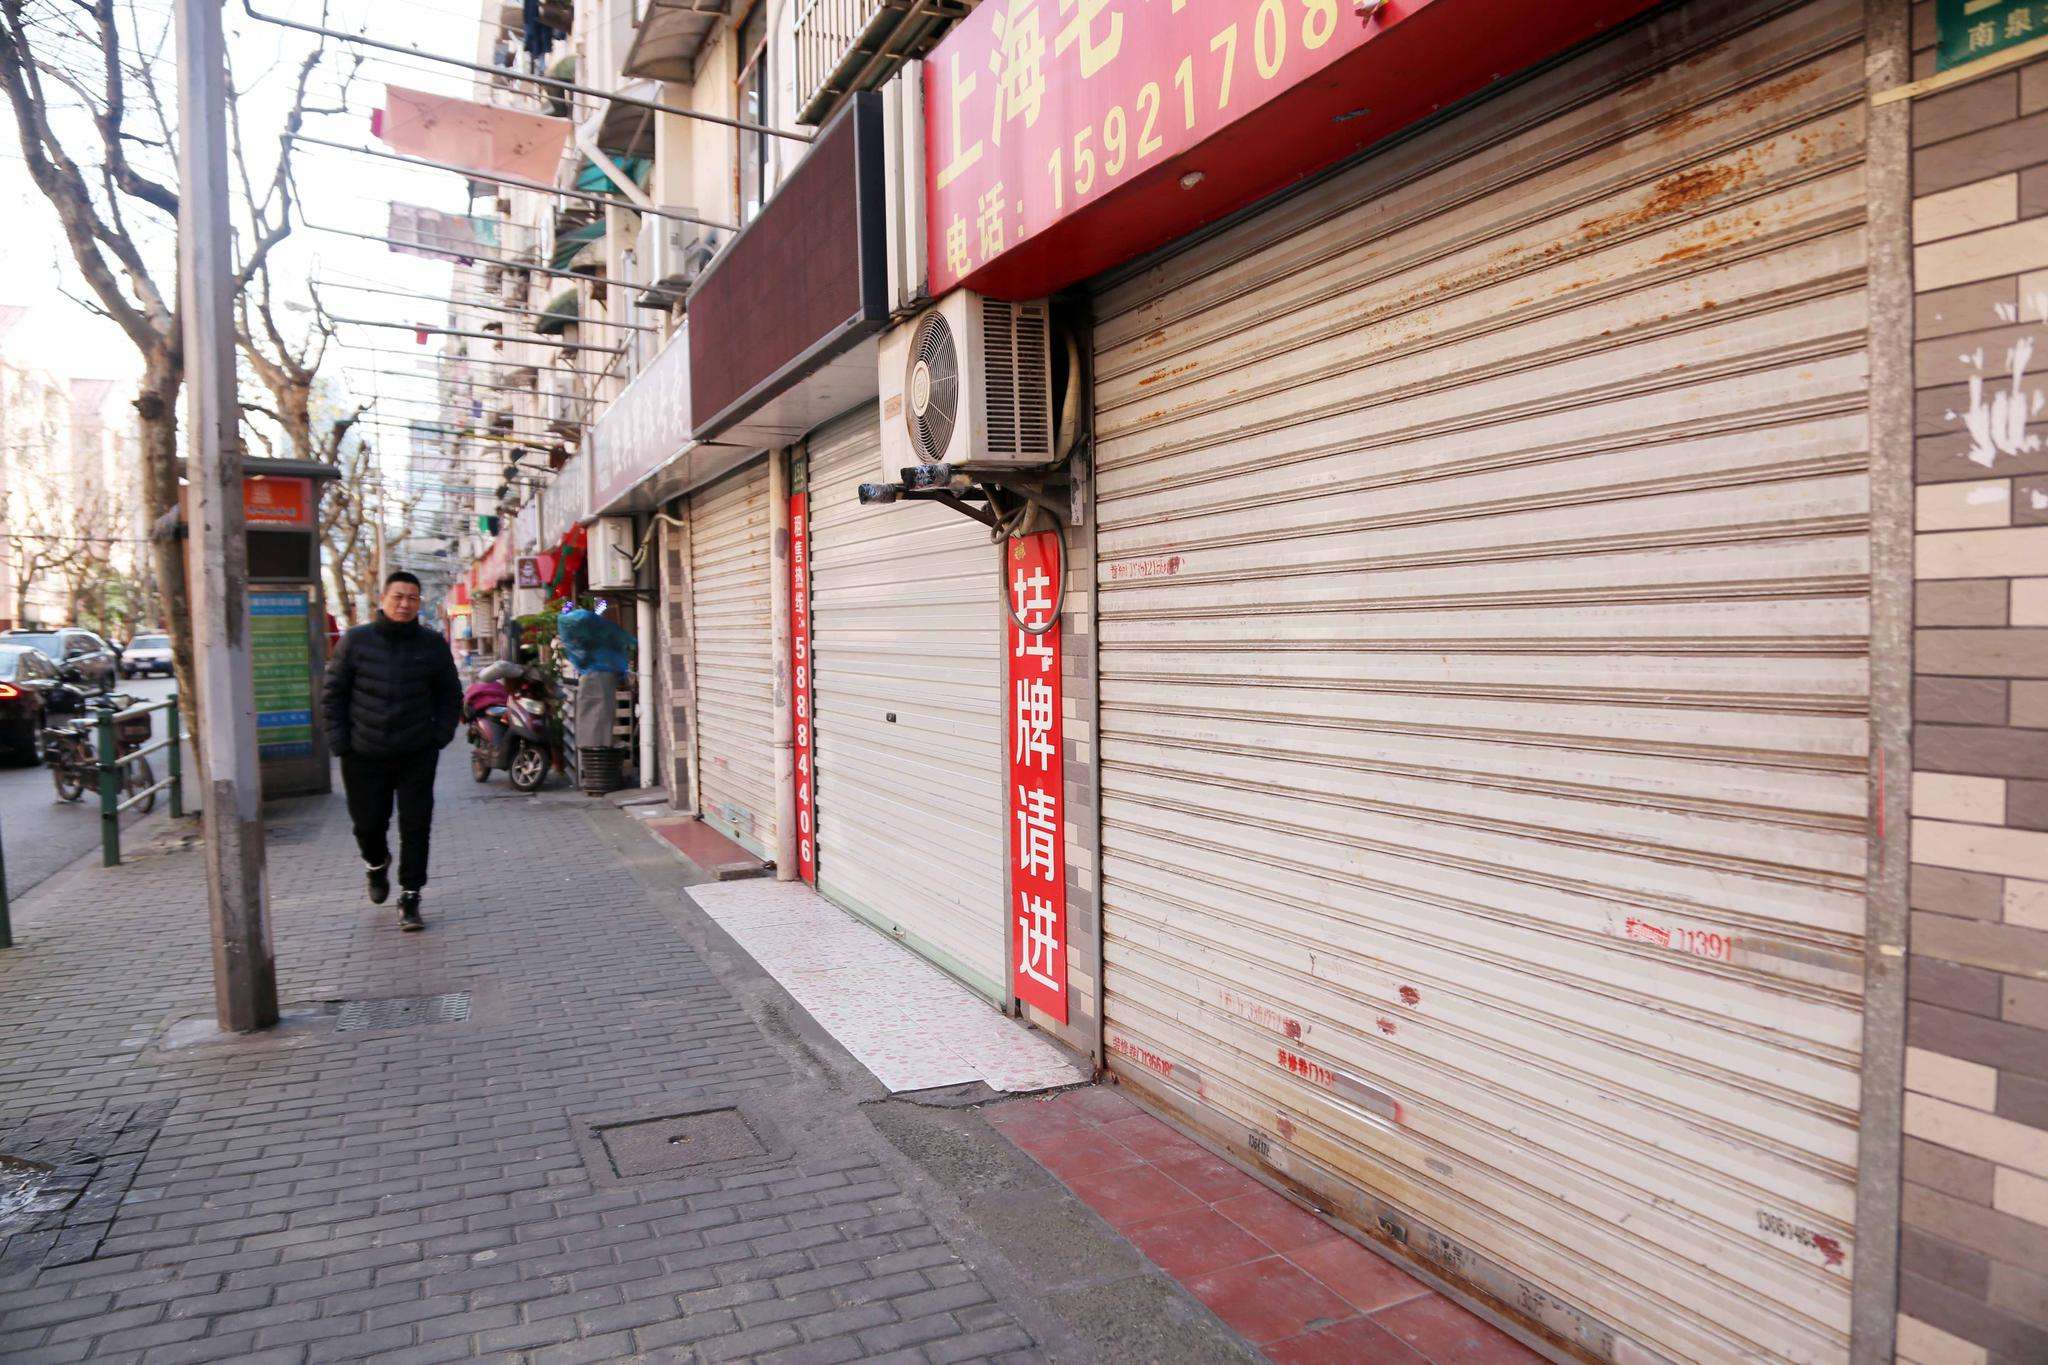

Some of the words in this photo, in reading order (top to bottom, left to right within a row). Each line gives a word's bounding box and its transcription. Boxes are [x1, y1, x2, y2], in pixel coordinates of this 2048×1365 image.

[937, 0, 1207, 190] 上海毛
[1967, 5, 2048, 52] 南泉
[1013, 566, 1059, 993] 挂牌请进
